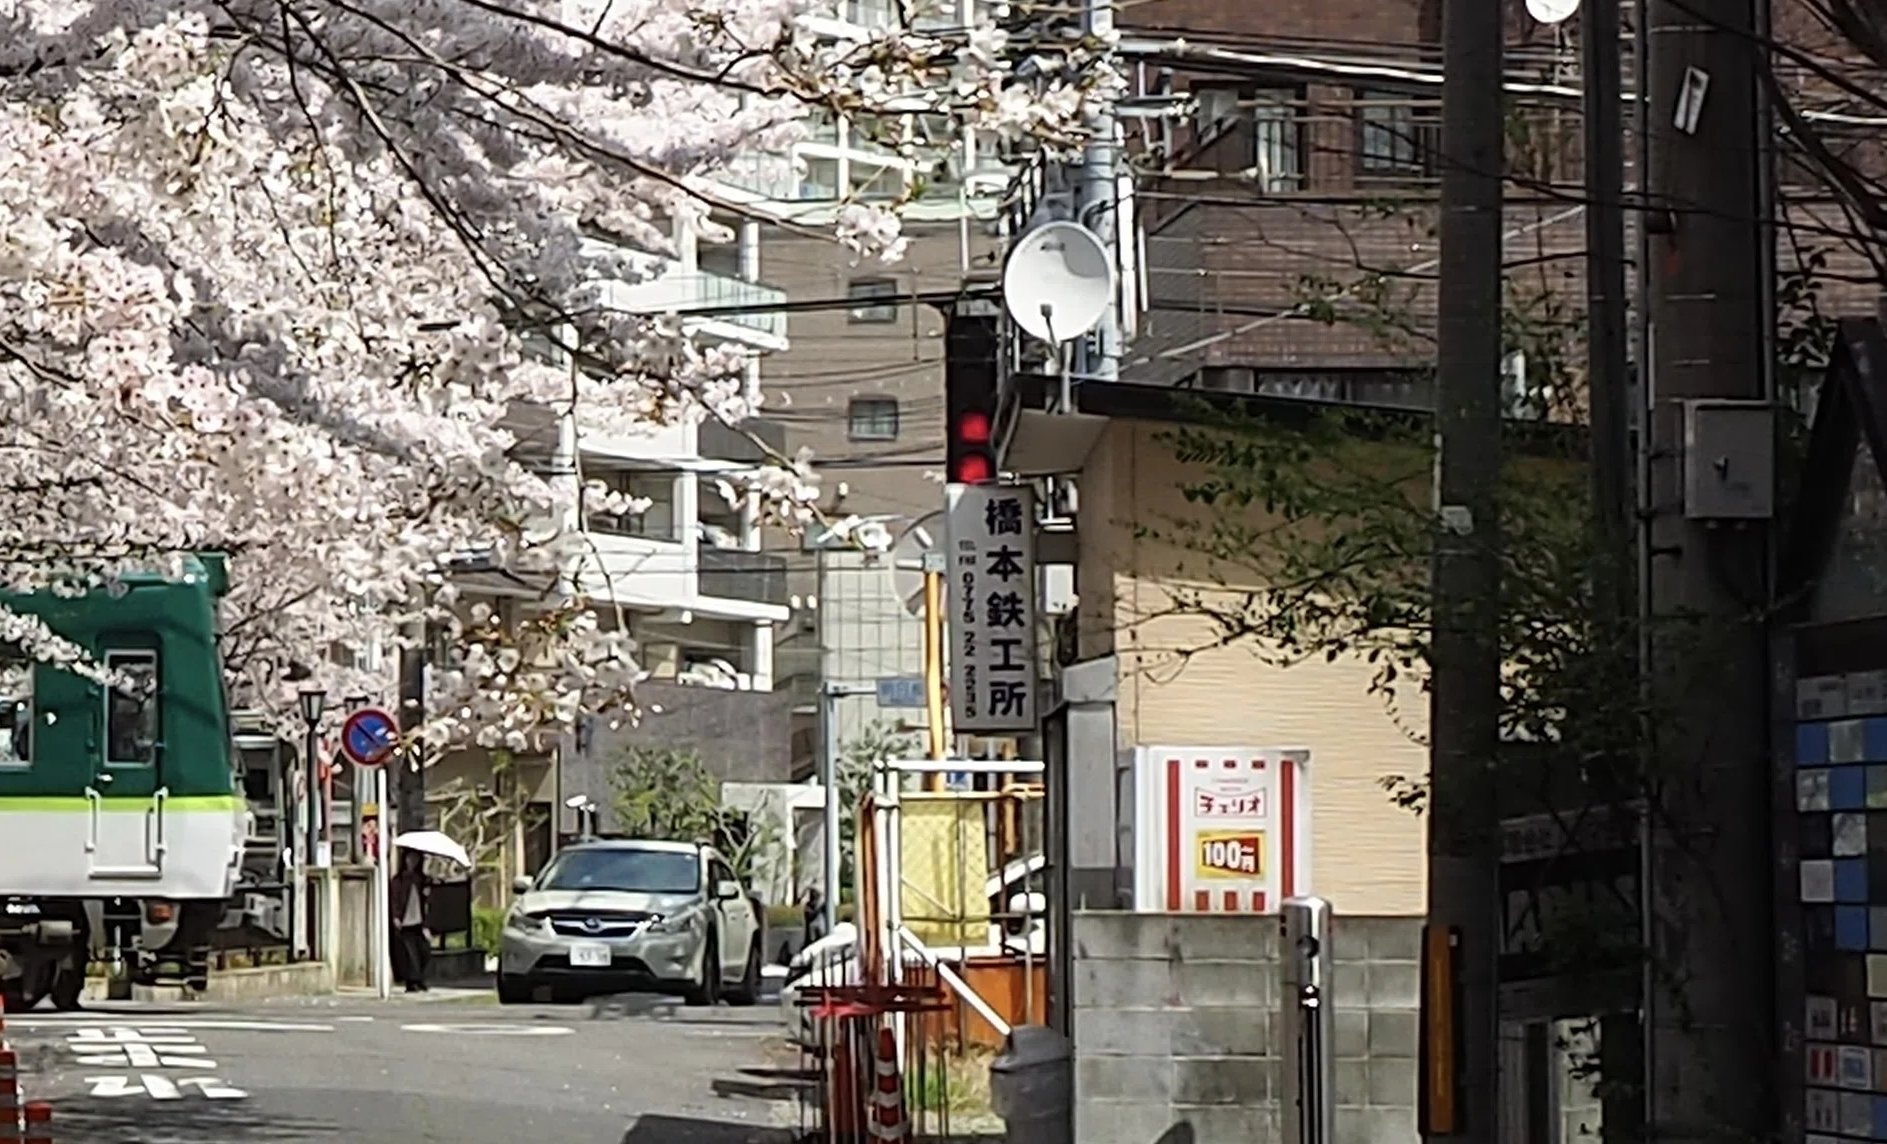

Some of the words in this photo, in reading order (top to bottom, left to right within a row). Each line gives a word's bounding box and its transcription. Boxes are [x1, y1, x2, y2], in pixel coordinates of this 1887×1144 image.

[962, 571, 975, 624] 0775
[985, 497, 1027, 717] 橋本鉄工所
[963, 631, 975, 657] 22
[1199, 795, 1261, 814] チェリオ
